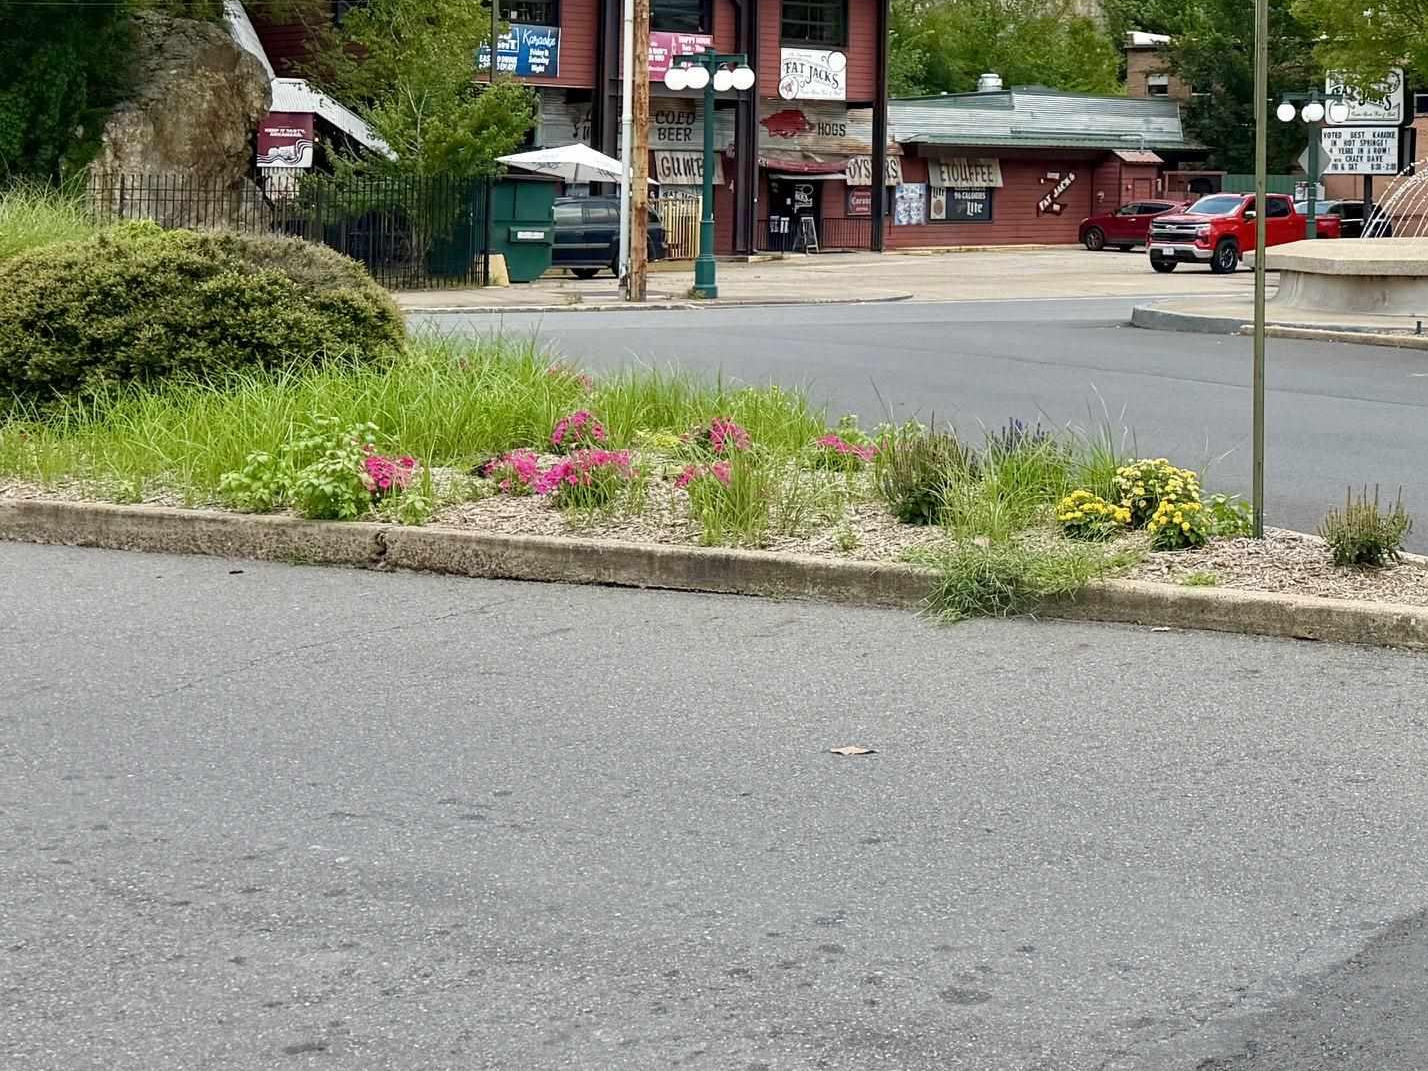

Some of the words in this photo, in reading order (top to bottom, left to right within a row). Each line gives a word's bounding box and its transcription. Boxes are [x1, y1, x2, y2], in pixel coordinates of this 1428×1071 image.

[522, 28, 556, 47] Karaoke
[784, 61, 805, 74] FAT
[806, 65, 839, 89] JACKS
[655, 111, 696, 125] COLD
[657, 127, 693, 141] BEER
[817, 122, 846, 137] HOGS
[660, 156, 706, 179] GUMB
[849, 157, 898, 179] OYSRS
[940, 161, 994, 183] ETOUFFEE
[967, 201, 984, 216] Lite
